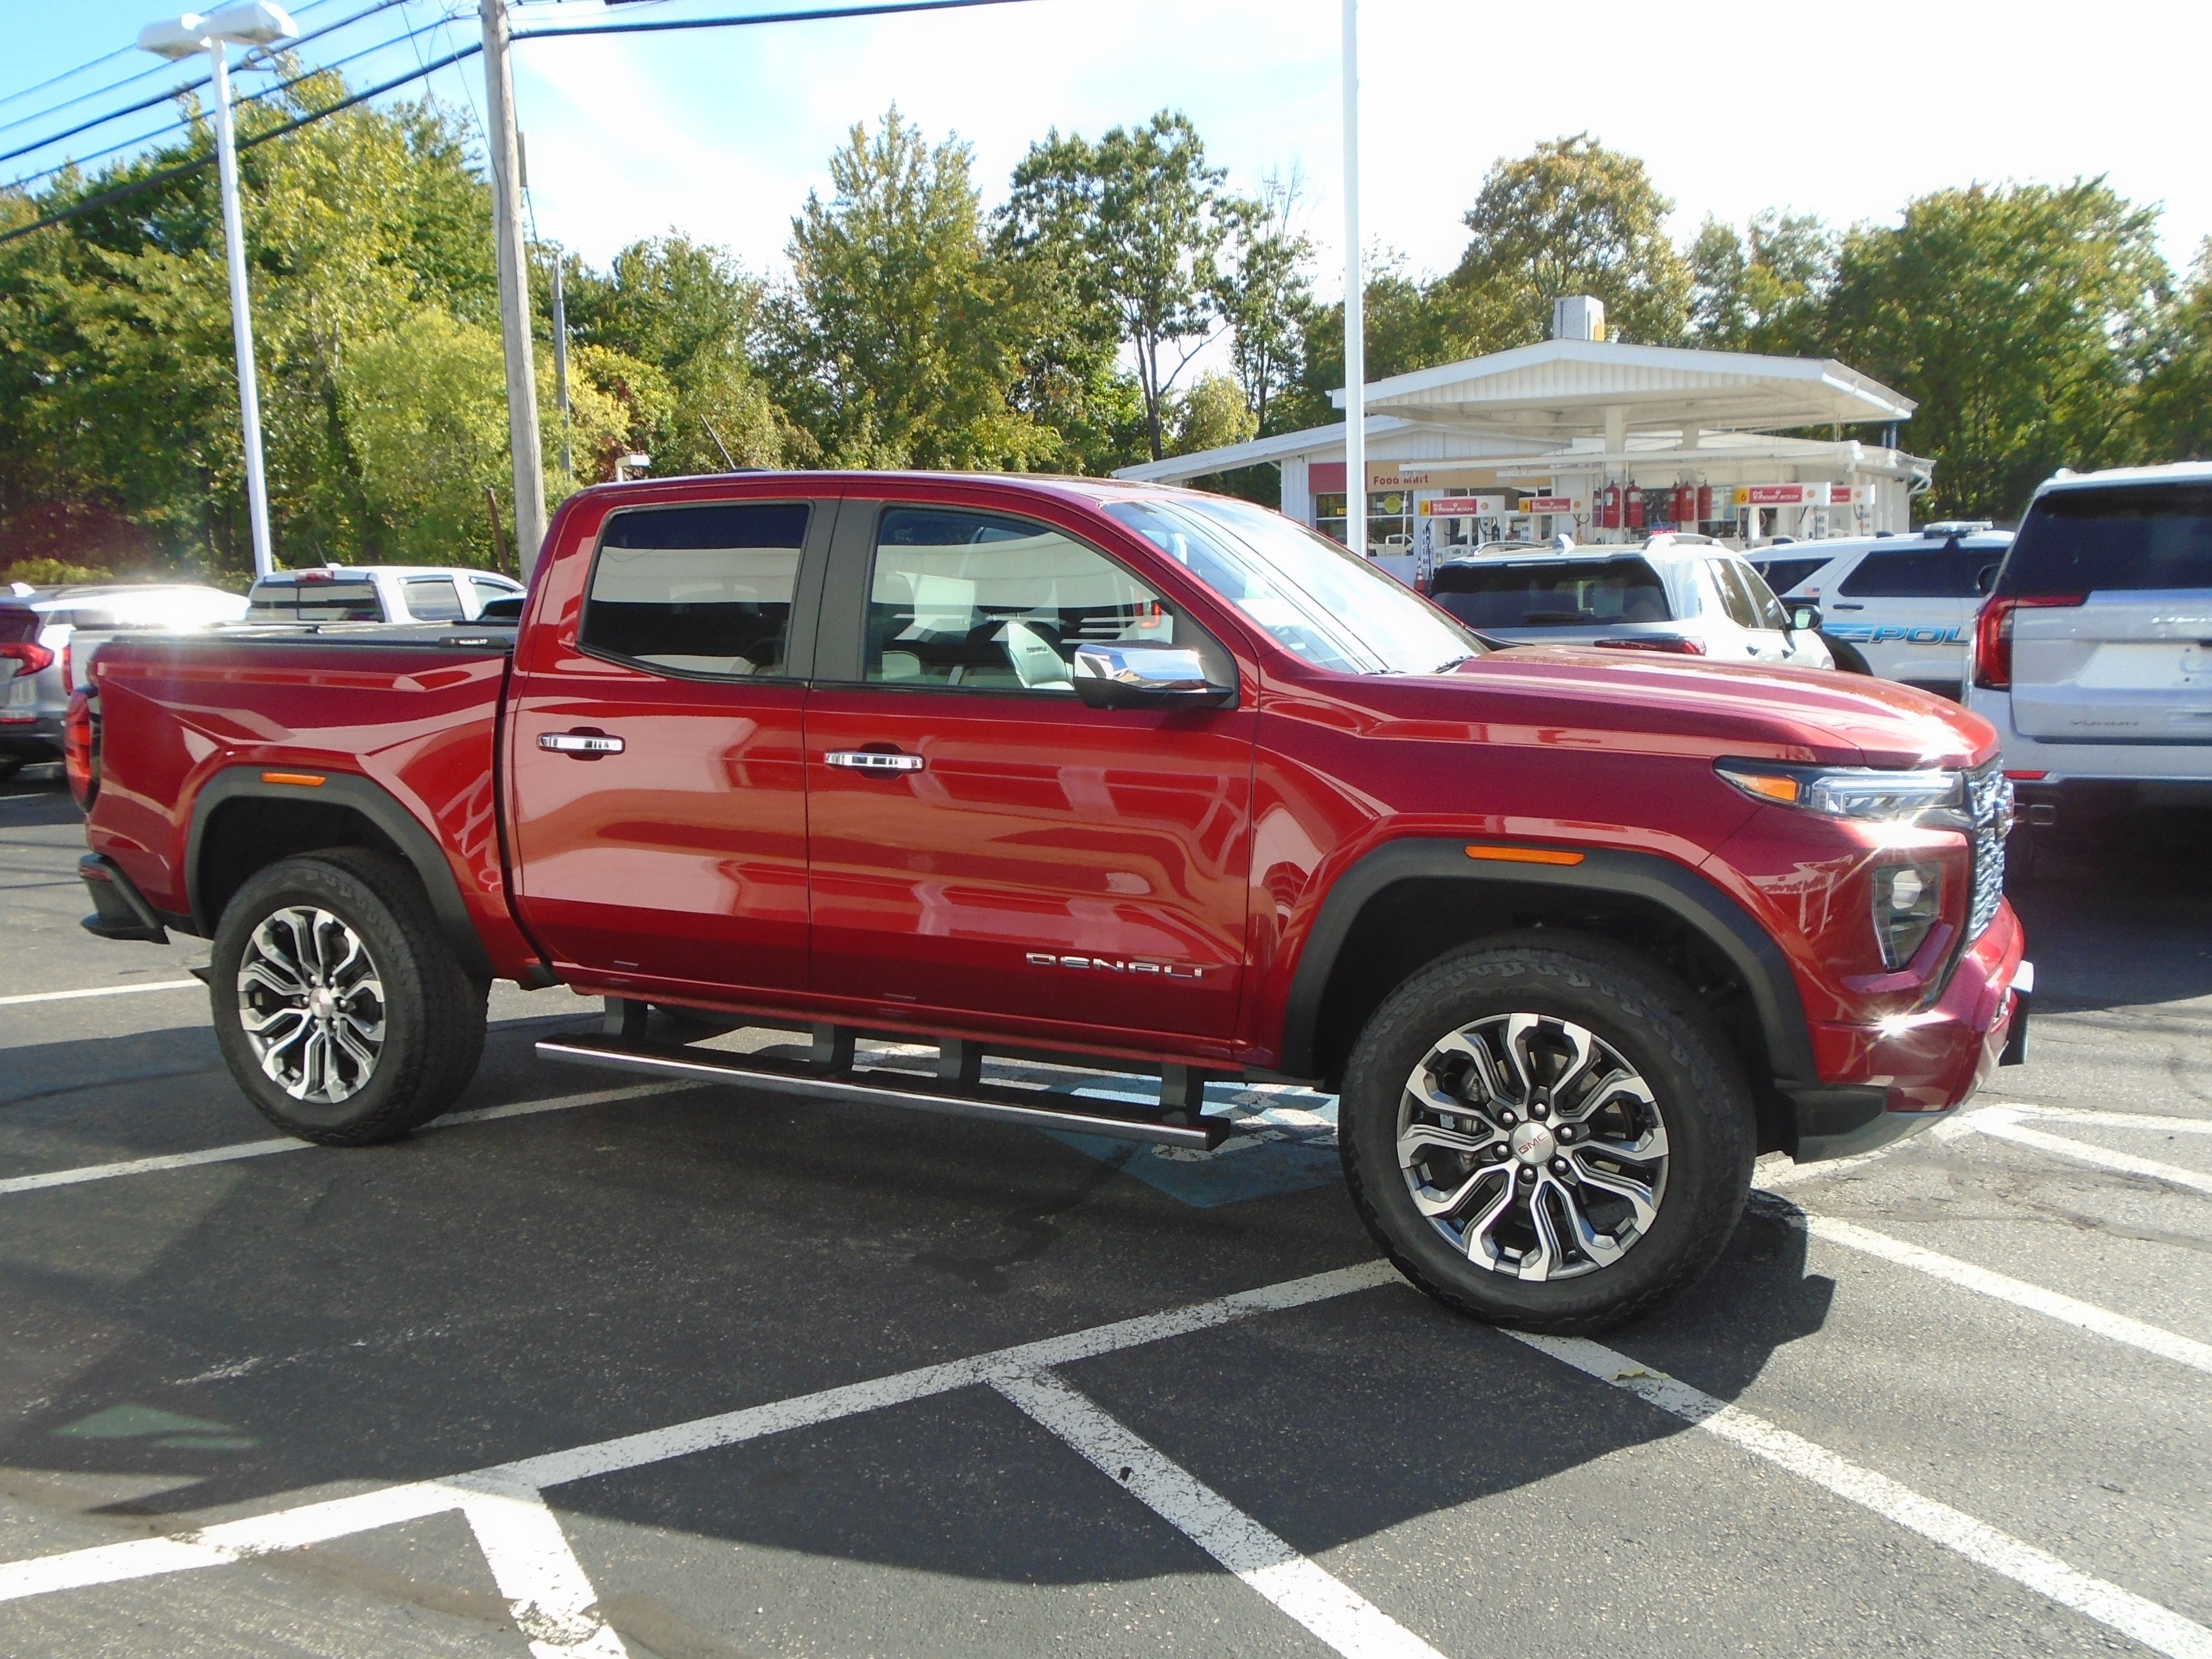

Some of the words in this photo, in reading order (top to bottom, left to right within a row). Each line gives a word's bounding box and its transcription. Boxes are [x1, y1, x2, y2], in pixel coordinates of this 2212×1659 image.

[1373, 475, 1399, 485] Food
[1741, 492, 1747, 501] 6
[1424, 504, 1429, 512] 8
[1026, 952, 1202, 979] DENALI
[1518, 1131, 1548, 1155] GMC
